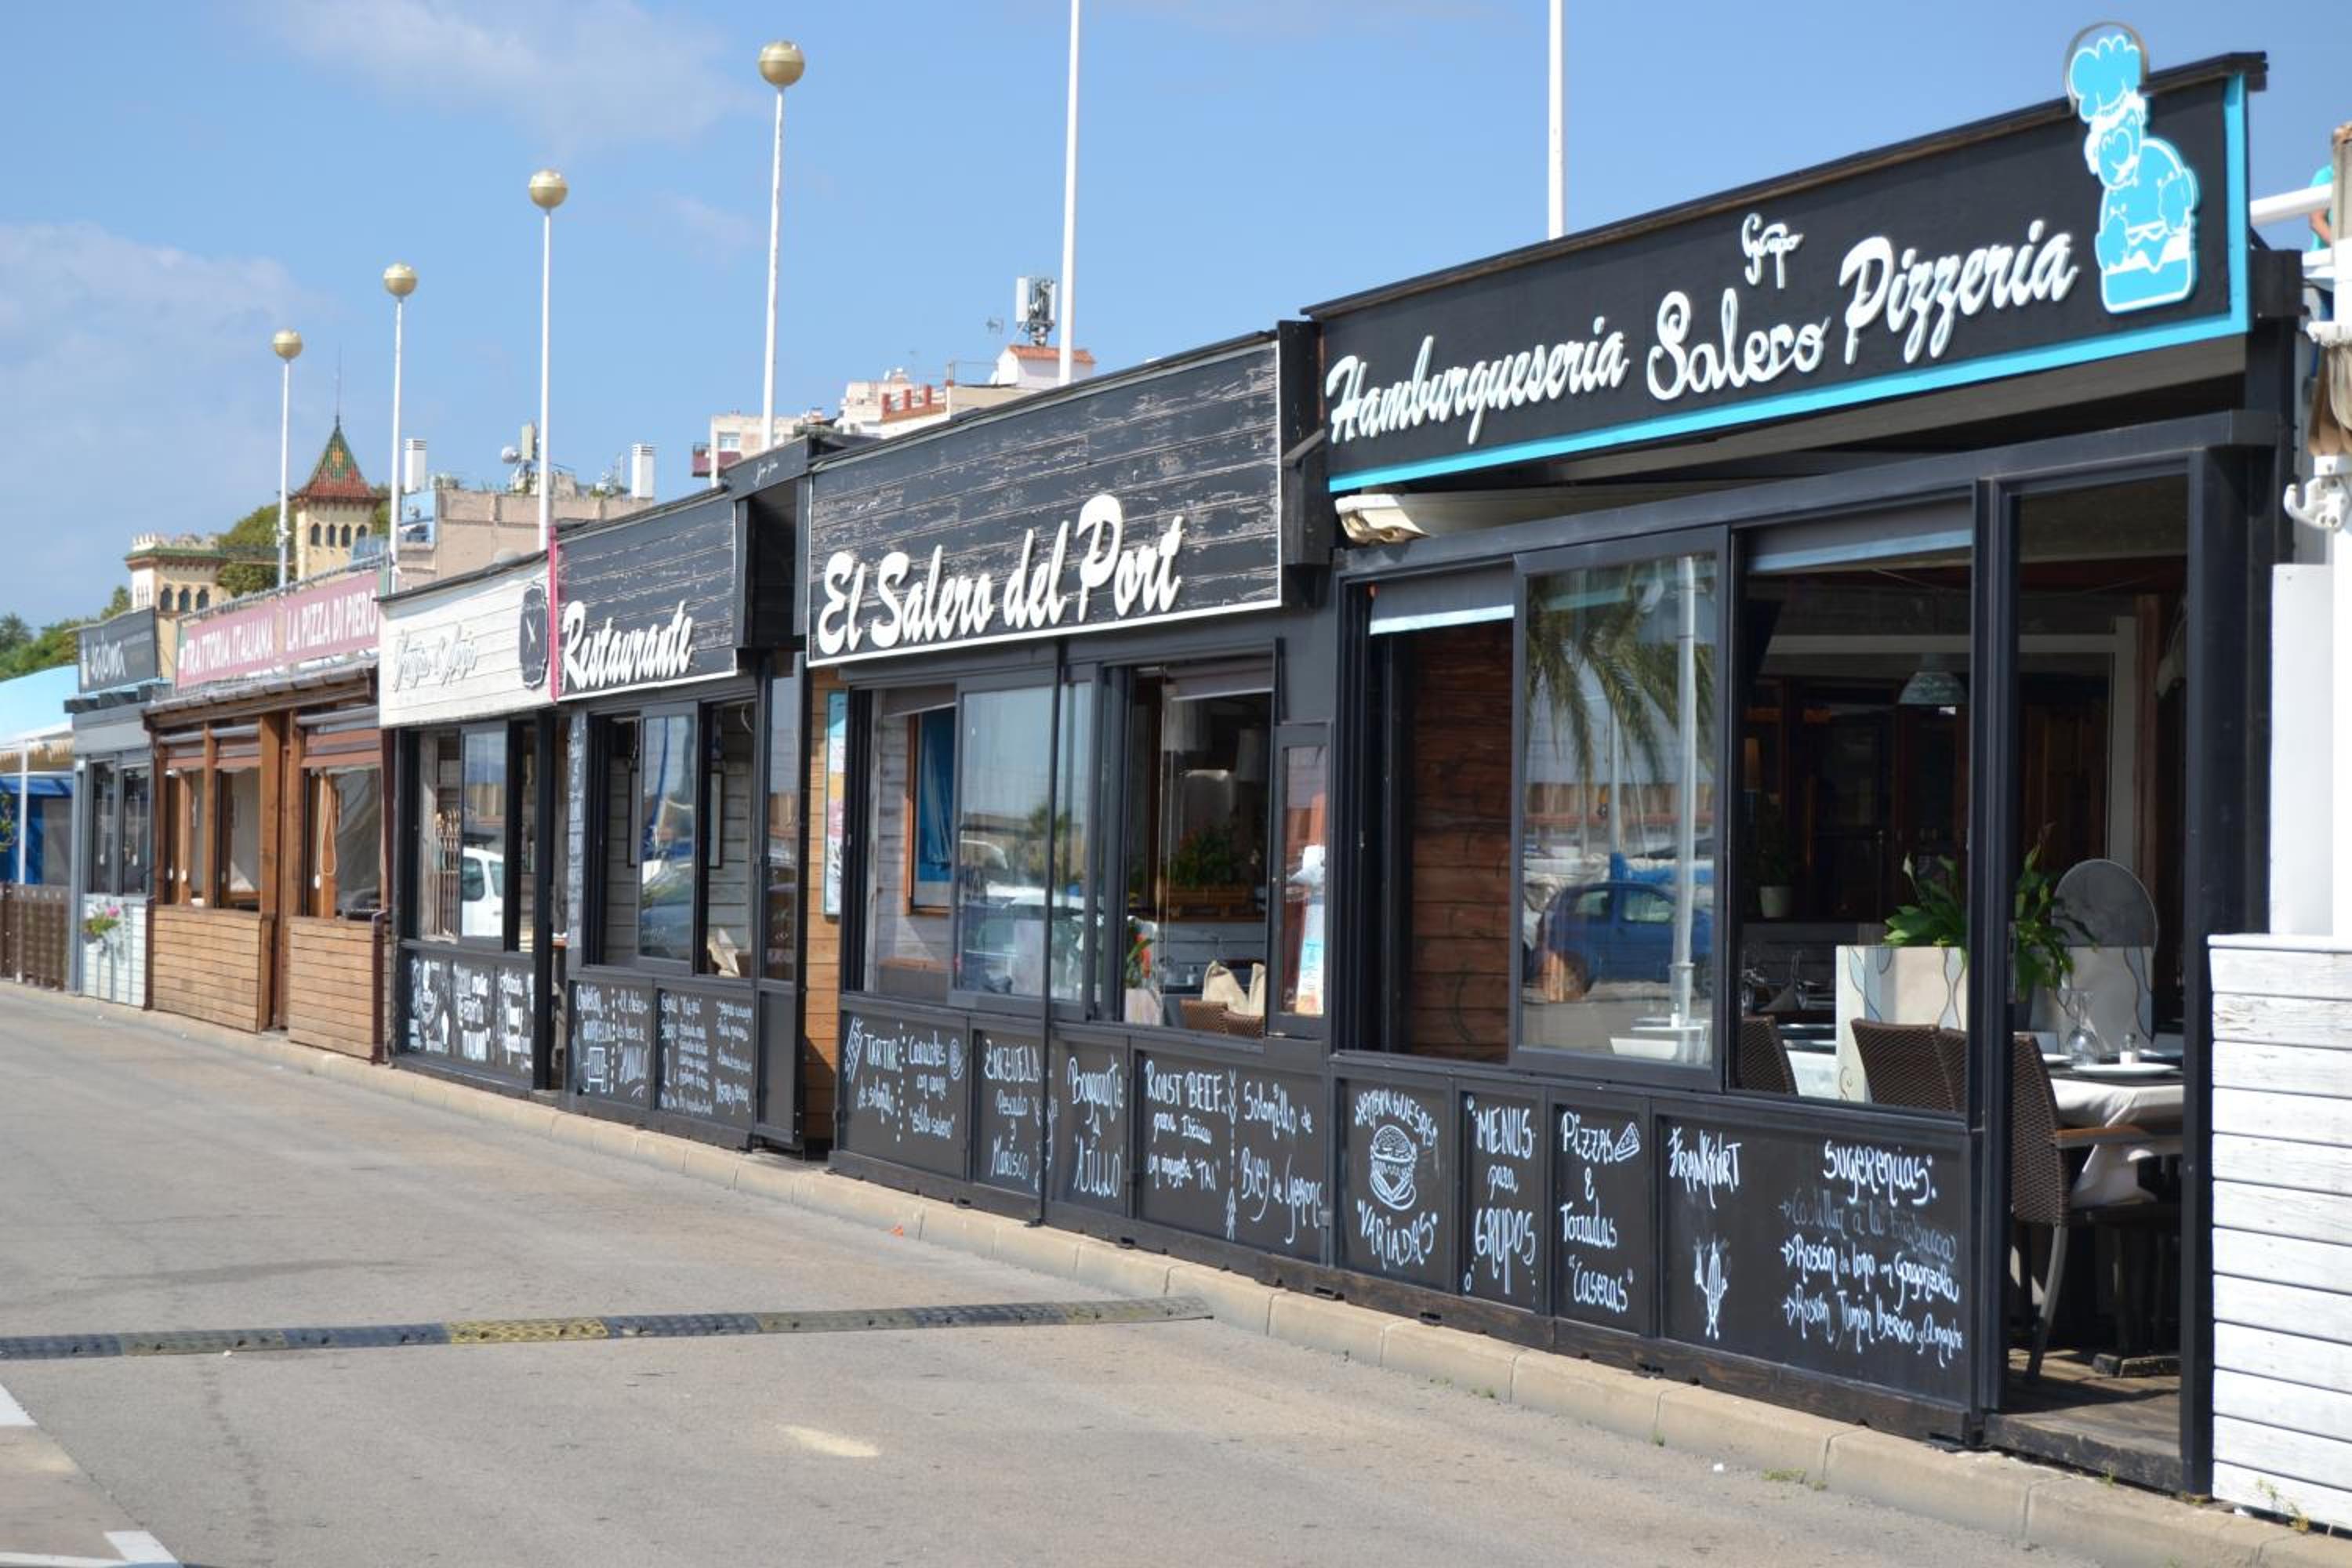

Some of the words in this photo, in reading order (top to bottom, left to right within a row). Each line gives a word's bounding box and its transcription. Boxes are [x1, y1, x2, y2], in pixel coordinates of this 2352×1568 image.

[1326, 315, 1631, 445] Hamburgueseria
[1646, 289, 1831, 401] Salero
[1838, 219, 2081, 365] Pizzeria
[817, 551, 867, 655] El
[871, 543, 995, 649] Salero
[1003, 519, 1069, 629] del
[1076, 494, 1186, 622] Port
[186, 624, 230, 675] TRATTORIA
[232, 615, 274, 665] ITALIANA
[286, 608, 299, 652] LA
[302, 601, 330, 648] PIZZA
[332, 599, 344, 641] DI
[347, 588, 379, 638] PIERO
[561, 599, 694, 694] Restaurante
[863, 1033, 899, 1071] TARTAR
[983, 1037, 1041, 1083] ZARZUELA
[1144, 1059, 1183, 1106] ROAST
[1185, 1070, 1223, 1112] BEEF
[1475, 1105, 1533, 1160] MENUS
[1240, 1145, 1270, 1222] Buey
[1487, 1164, 1519, 1201] para
[1475, 1207, 1535, 1295] GRUPOS
